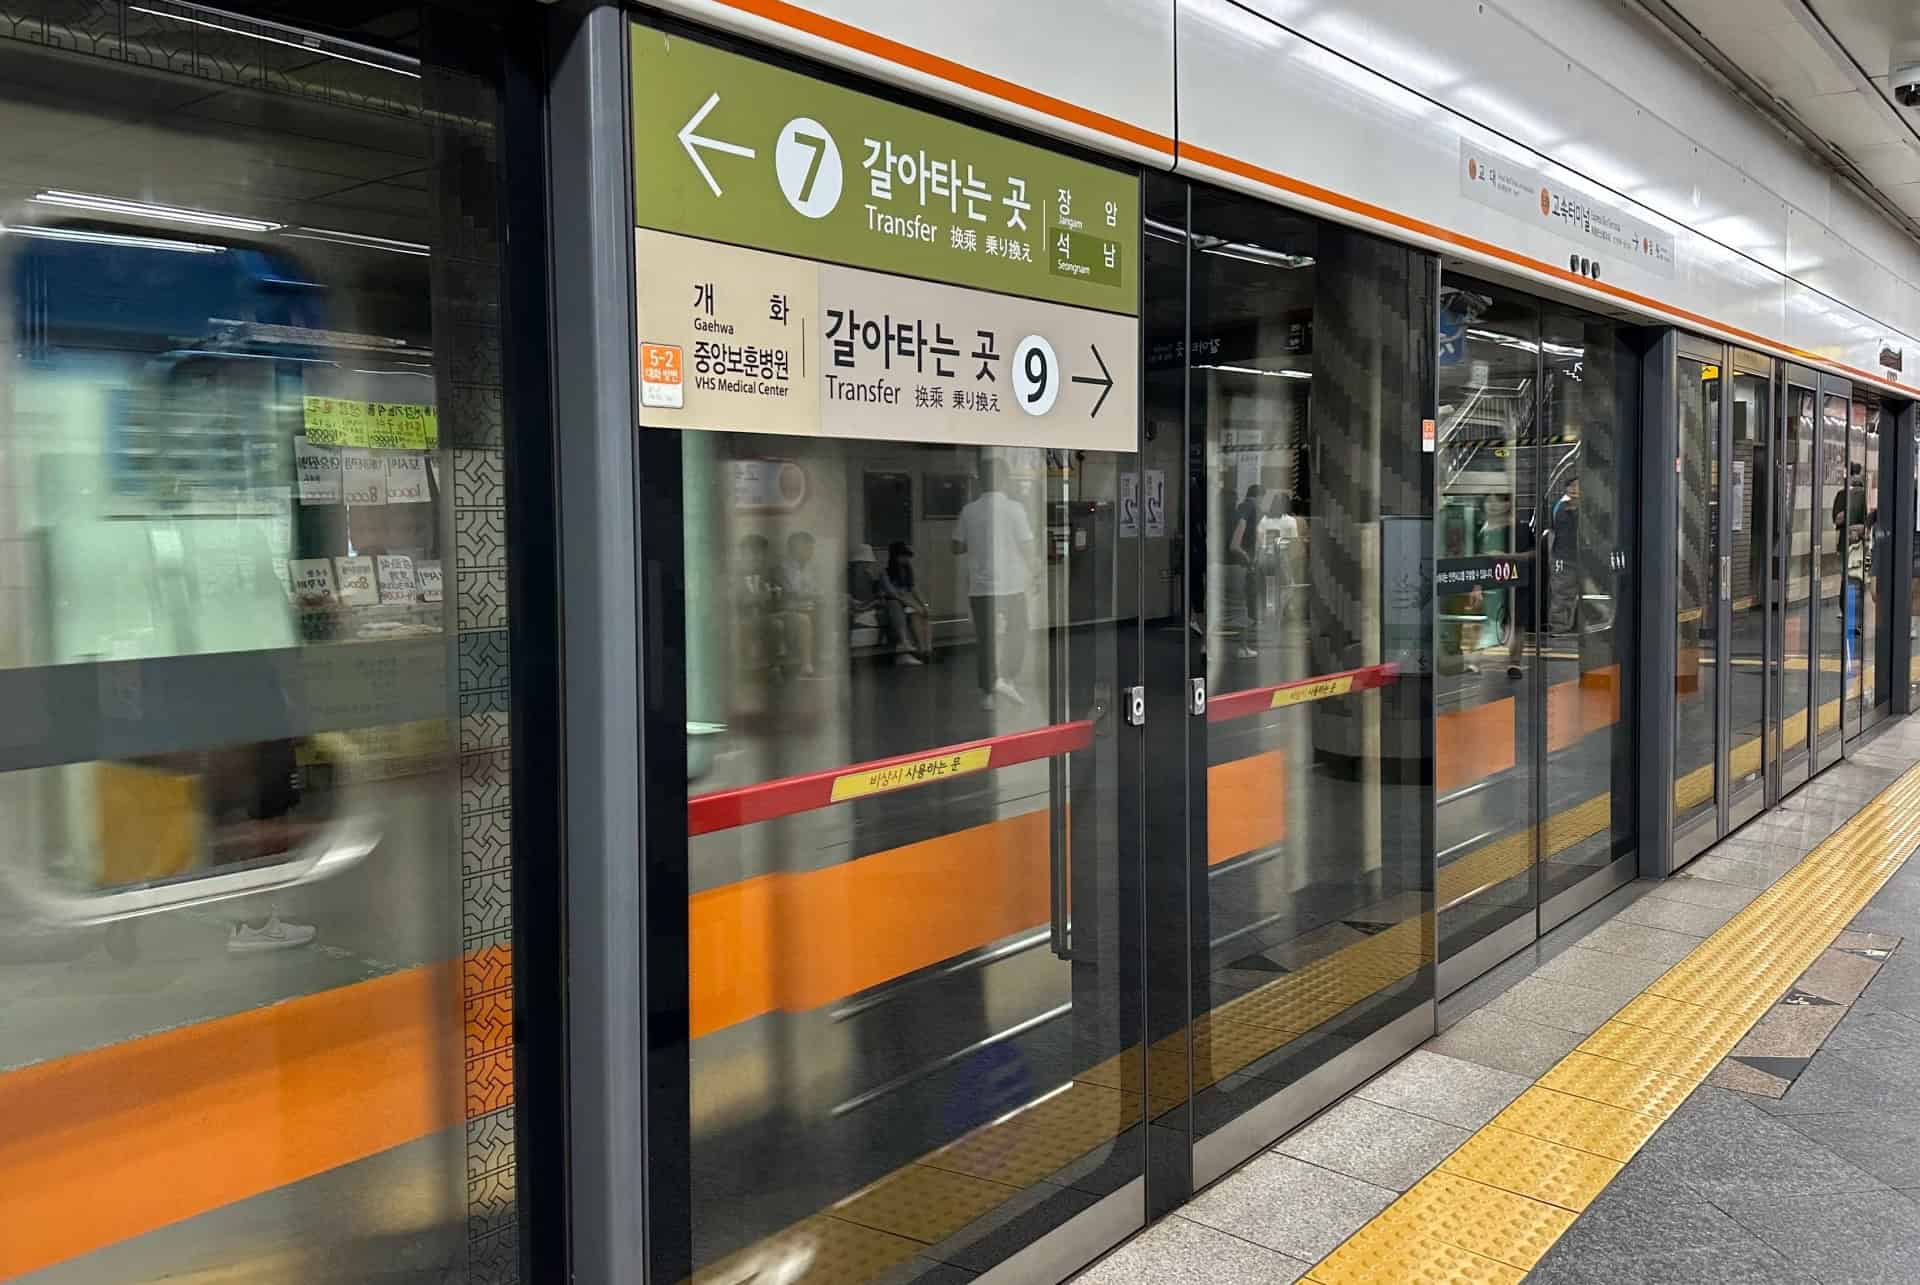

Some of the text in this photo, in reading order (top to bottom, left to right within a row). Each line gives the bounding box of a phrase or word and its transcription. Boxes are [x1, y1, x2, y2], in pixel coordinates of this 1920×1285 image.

[793, 131, 826, 202] 7
[862, 137, 1032, 232] 갈아타는 곳
[864, 204, 937, 243] Transfer
[1057, 188, 1118, 227] 장 암
[1551, 194, 1591, 233] 고속터미널
[1057, 233, 1116, 268] 석 남
[694, 283, 789, 326] 개 화
[694, 317, 735, 335] Gaehwa
[650, 349, 673, 368] 5-2
[694, 341, 789, 381] 중앙보훈병원
[825, 309, 1000, 383] 갈아타는 곳
[695, 376, 789, 397] VHS Medical Center
[825, 374, 901, 405] Transfer
[1024, 347, 1049, 403] 9
[870, 756, 961, 789] 비상시 사용하는 문
